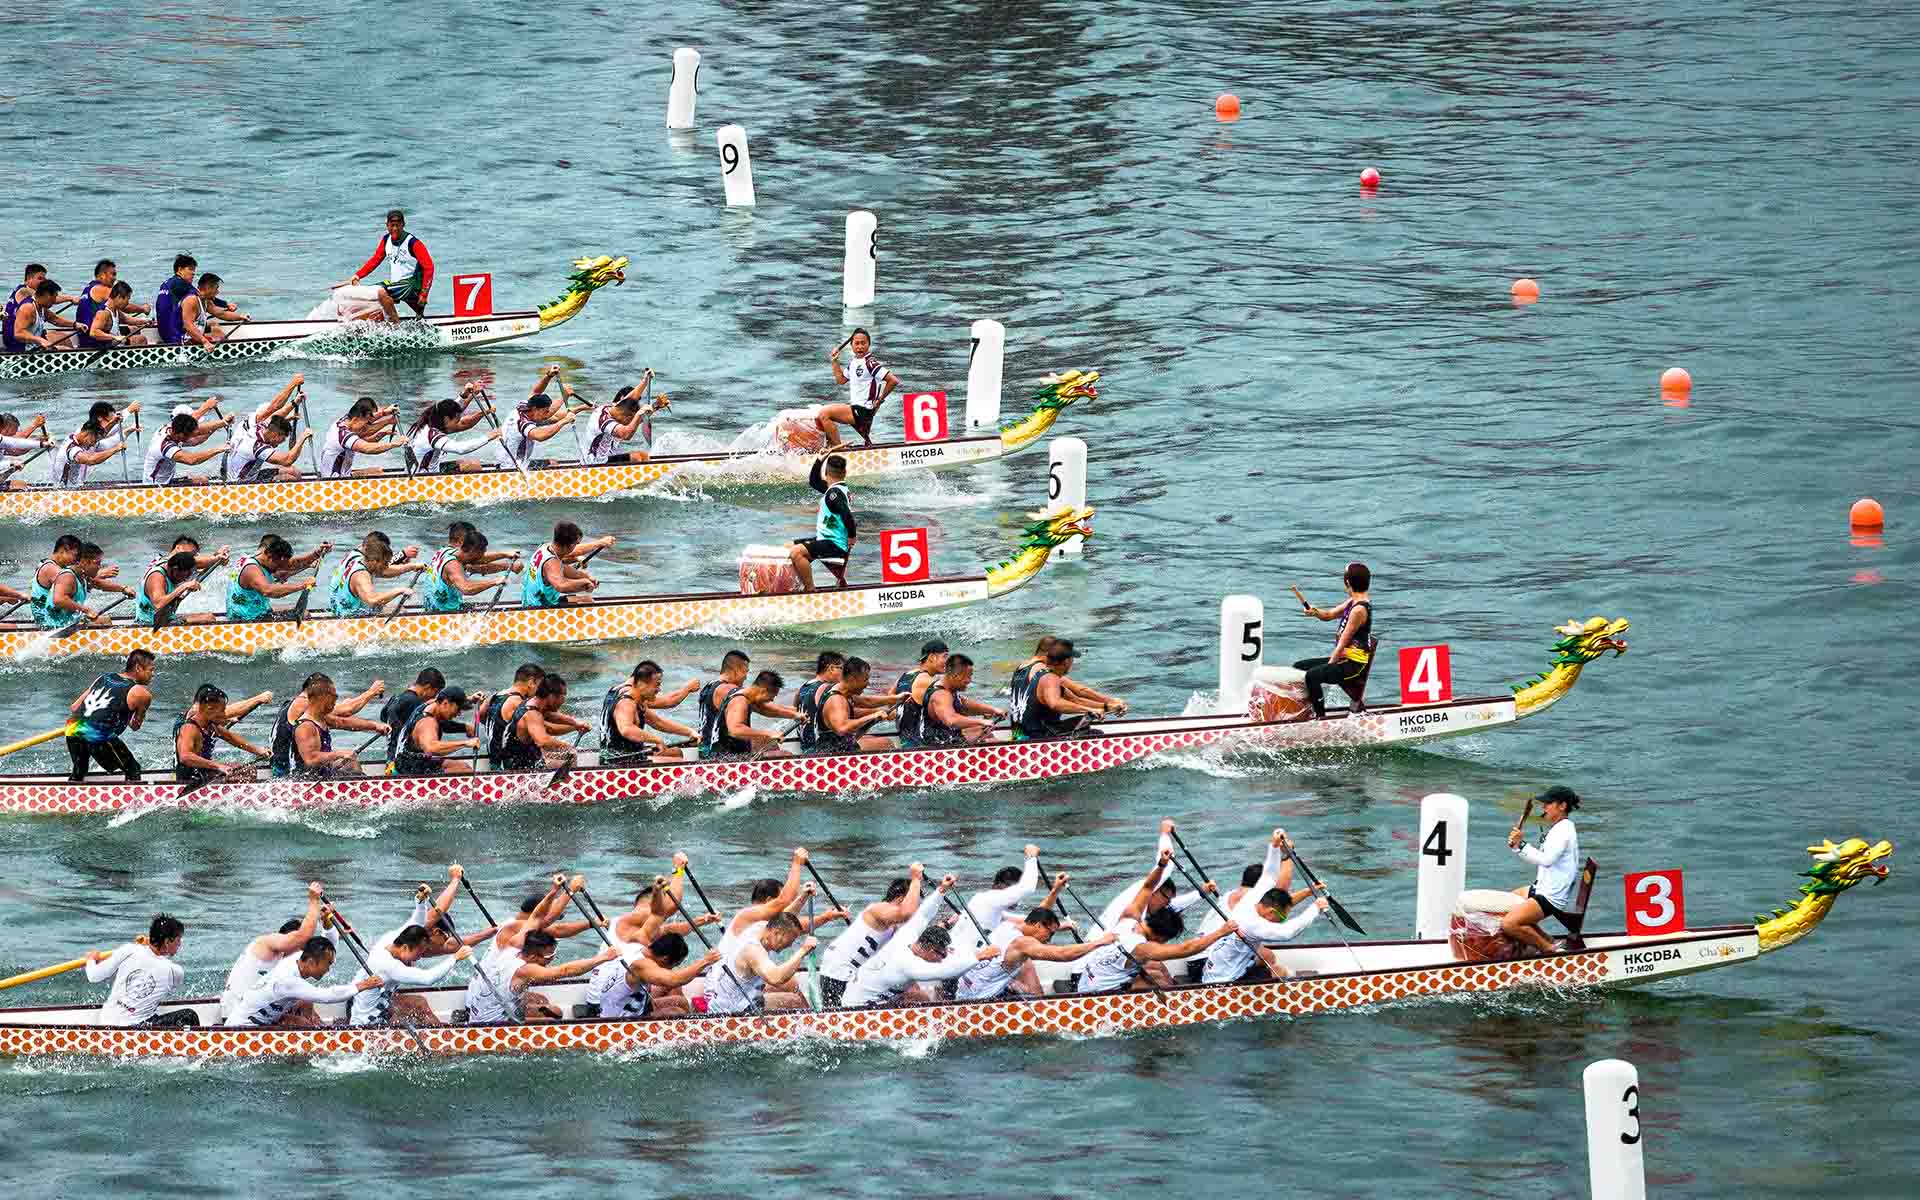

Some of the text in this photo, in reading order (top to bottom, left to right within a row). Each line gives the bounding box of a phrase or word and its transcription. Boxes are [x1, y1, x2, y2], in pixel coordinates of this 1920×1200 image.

[722, 143, 739, 175] 9
[459, 276, 486, 311] 7
[451, 325, 489, 336] HKCDBA
[913, 394, 940, 440] 6
[900, 447, 944, 460] HKCDBA
[889, 532, 922, 576] 5
[878, 589, 925, 602] HKCDBA
[1241, 620, 1262, 662] 5
[1408, 647, 1442, 701] 4
[1399, 712, 1449, 727] HKCDBA
[1423, 821, 1452, 866] 4
[1634, 875, 1675, 927] 3
[1623, 948, 1682, 966] HKCDBA
[1624, 963, 1655, 975] 17-M20
[1620, 1085, 1640, 1145] 3
